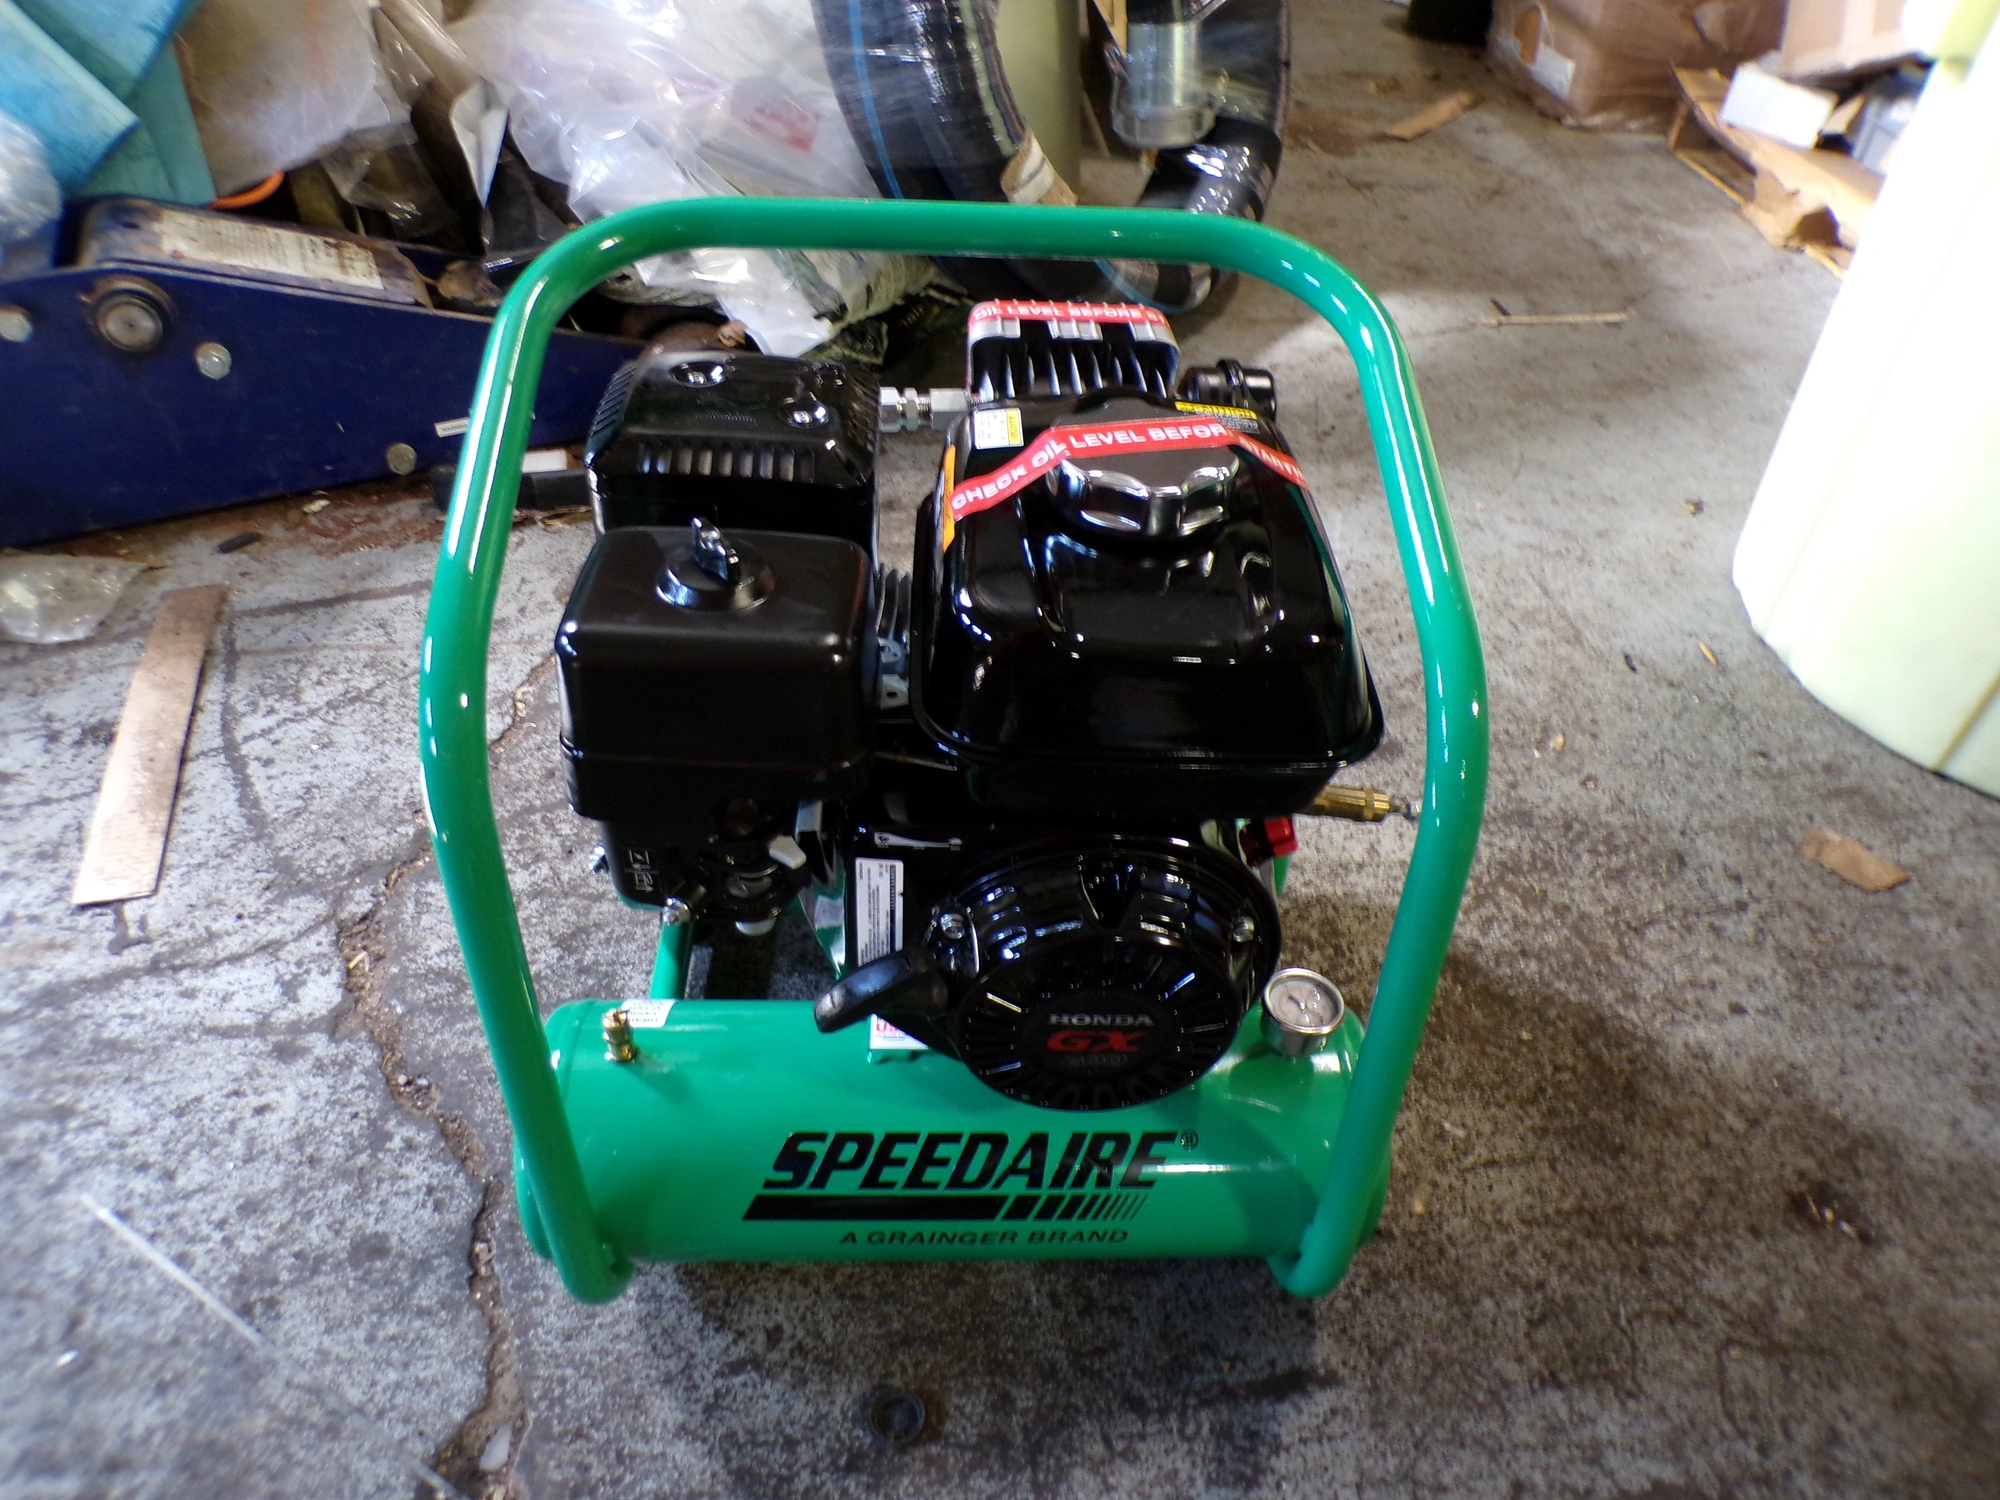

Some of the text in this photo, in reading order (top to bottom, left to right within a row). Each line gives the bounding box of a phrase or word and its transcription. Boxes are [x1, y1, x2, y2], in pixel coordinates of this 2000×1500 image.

[974, 304, 1003, 320] OIL
[1006, 305, 1065, 317] LEVEL
[1068, 307, 1143, 318] BEFORE
[951, 464, 1028, 510] CHECK
[1031, 439, 1068, 468] OIL
[1069, 429, 1147, 449] LEVEL
[1048, 1012, 1155, 1027] HONDA
[1046, 1030, 1154, 1054] GX
[762, 1131, 1179, 1190] SPEEDAIRE
[838, 1229, 1129, 1247] A GRAINGER BRAND
